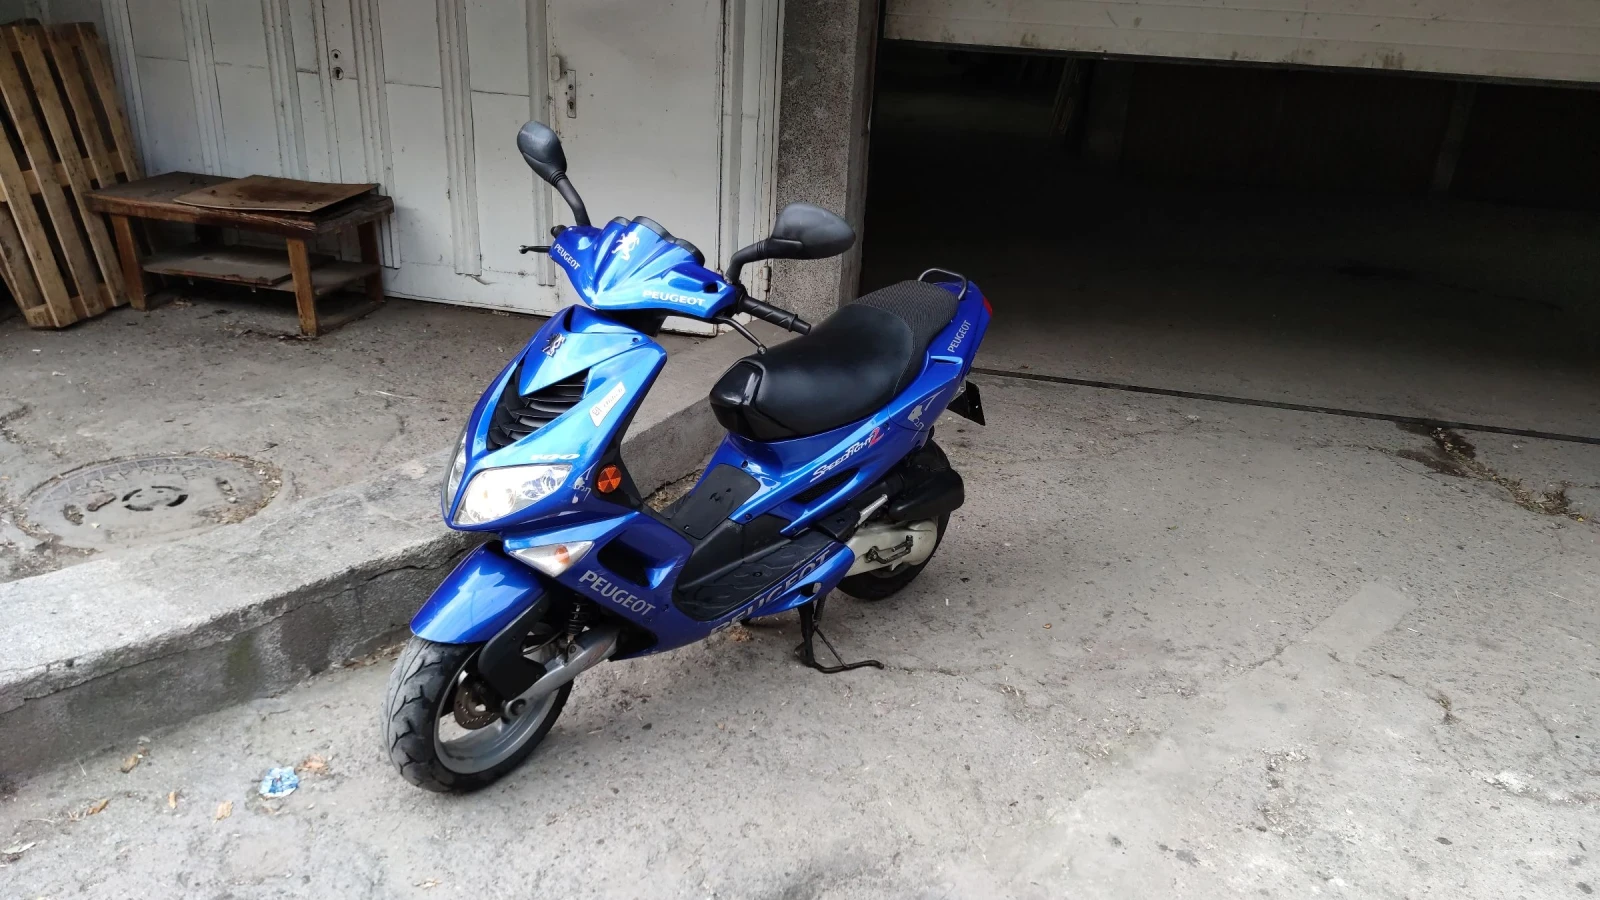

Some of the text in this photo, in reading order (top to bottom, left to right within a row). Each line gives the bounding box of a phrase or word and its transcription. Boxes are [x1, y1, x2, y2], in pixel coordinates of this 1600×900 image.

[554, 243, 580, 270] PEUGEOT
[642, 290, 706, 306] PEUGEOT
[947, 320, 971, 353] PEUGEOT
[578, 570, 656, 616] PEUGEOT
